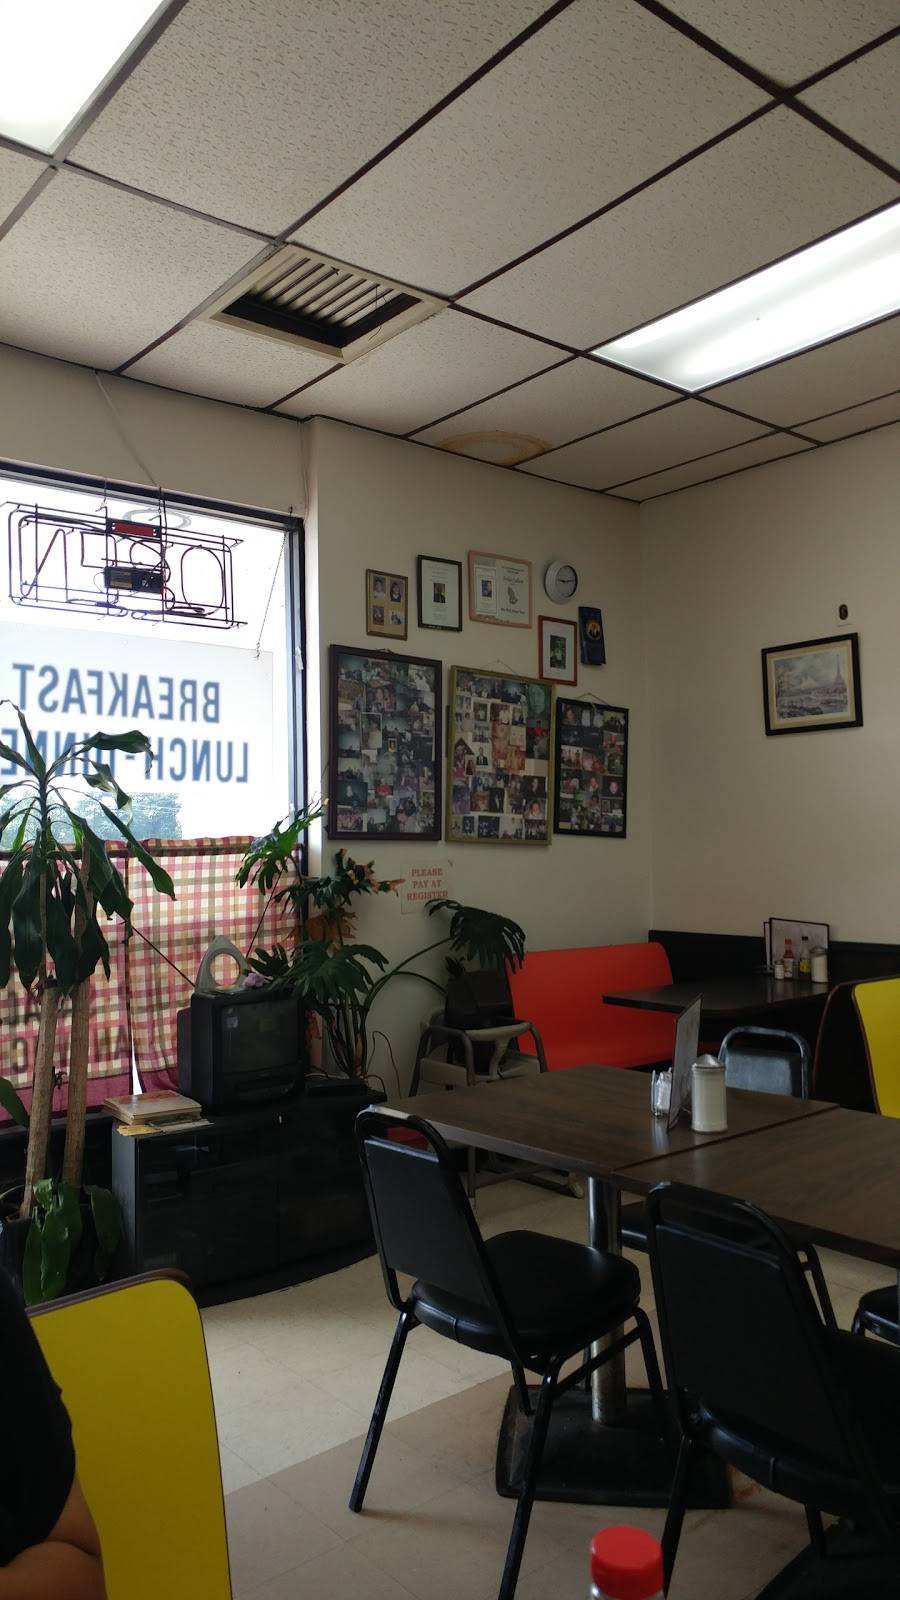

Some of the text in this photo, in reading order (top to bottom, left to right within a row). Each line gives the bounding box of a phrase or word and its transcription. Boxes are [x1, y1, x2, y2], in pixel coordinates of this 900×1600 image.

[411, 867, 444, 877] PLEASE
[412, 879, 442, 889] PAY AT
[407, 890, 449, 901] REGISTER
